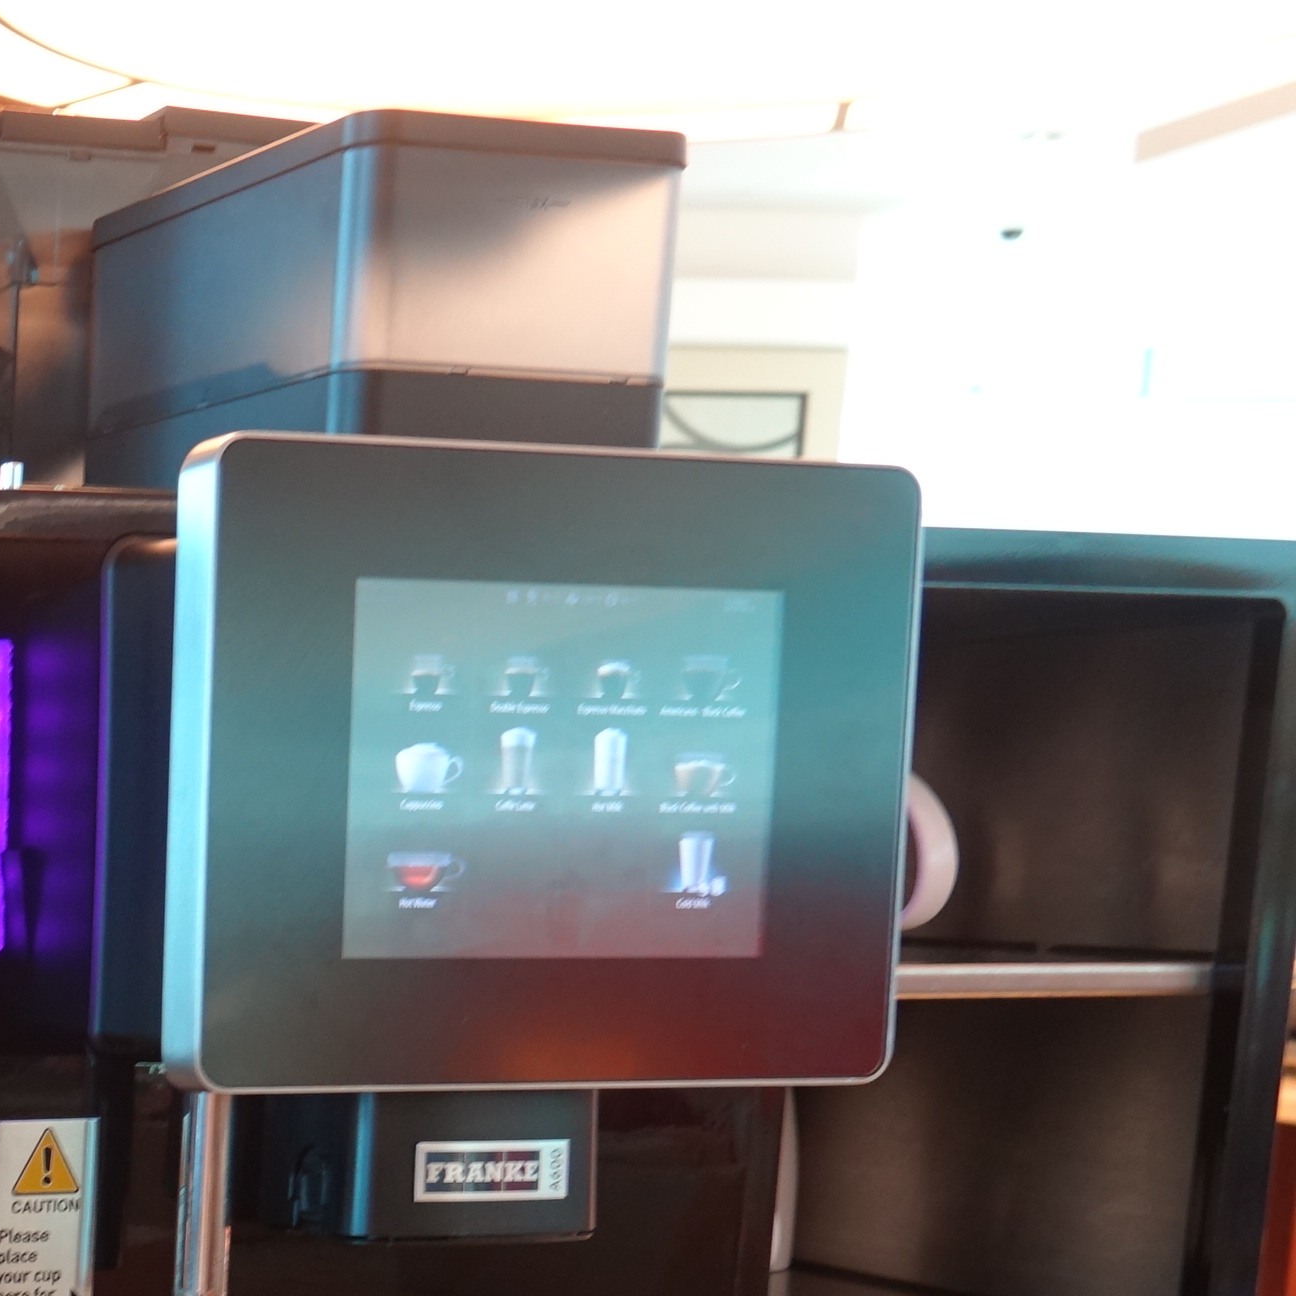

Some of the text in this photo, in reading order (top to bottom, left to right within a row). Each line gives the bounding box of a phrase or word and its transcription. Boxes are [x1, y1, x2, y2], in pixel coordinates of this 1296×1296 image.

[426, 1160, 539, 1184] FRANKE
[11, 1199, 79, 1214] CAUTION
[33, 1269, 62, 1285] cup
